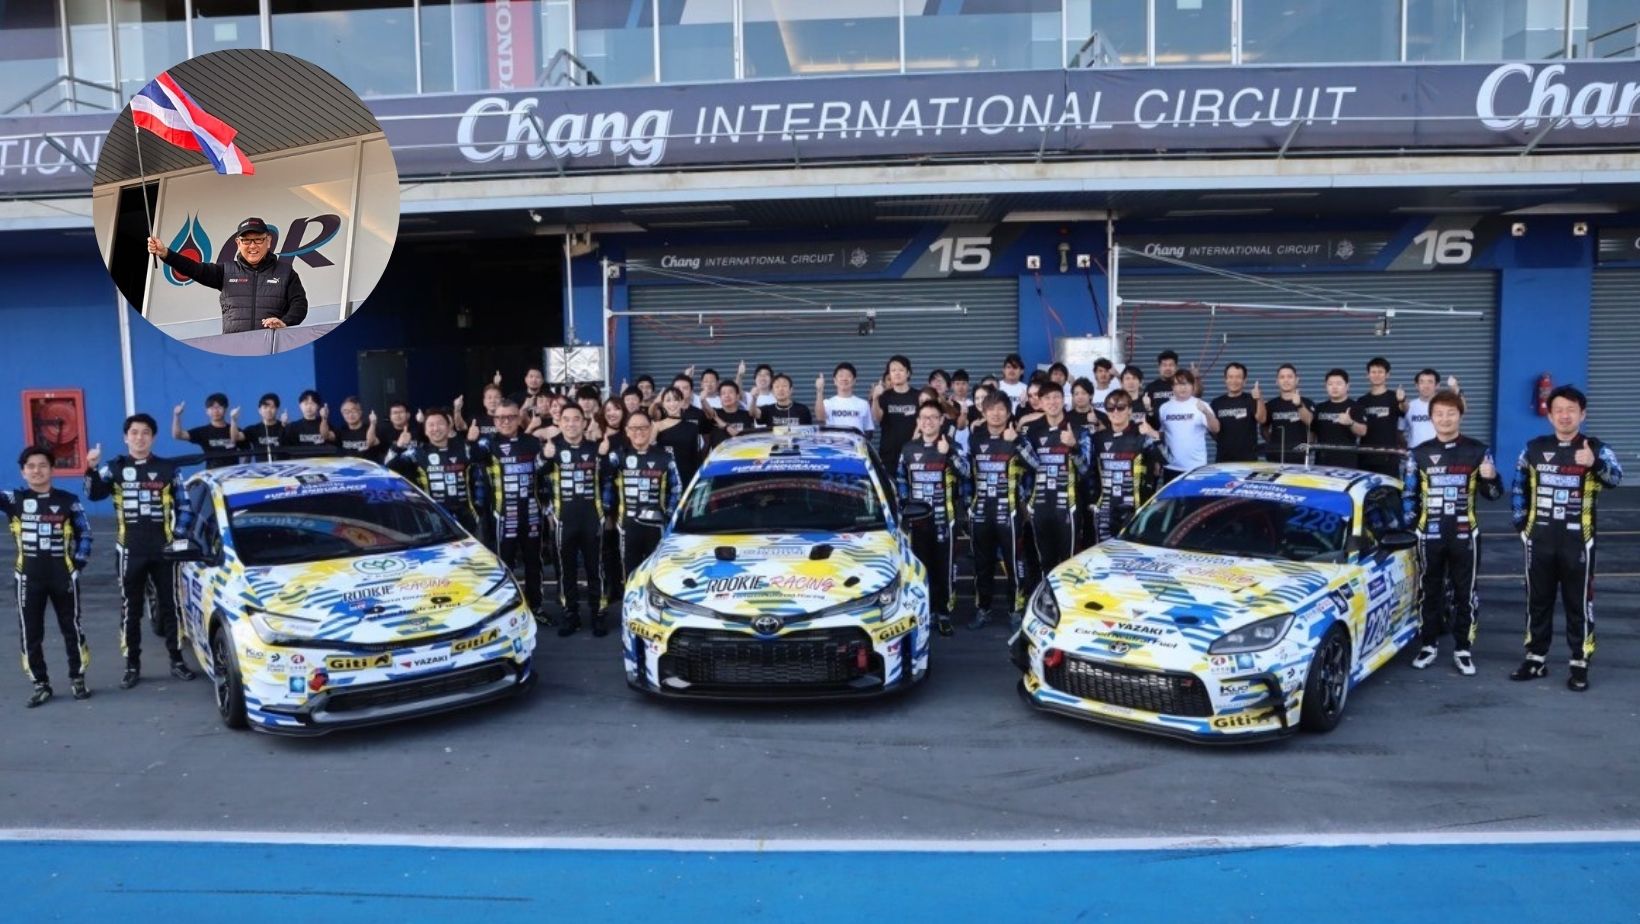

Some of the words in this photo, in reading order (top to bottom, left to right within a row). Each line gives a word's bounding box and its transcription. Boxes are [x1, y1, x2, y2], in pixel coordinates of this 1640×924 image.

[458, 97, 673, 166] Chang
[694, 87, 1111, 144] INTERNATIONAL
[1134, 86, 1356, 128] CIRCUIT
[929, 236, 992, 272] 15
[1143, 242, 1184, 259] Chang
[1189, 246, 1272, 255] INTERNATIONAL
[1276, 244, 1321, 255] CIRCUIT
[1413, 230, 1474, 265] 16
[660, 255, 700, 270] Chang
[705, 256, 787, 267] INTERNATIONAL
[791, 254, 834, 265] CIRCUIT
[1289, 506, 1340, 533] 228
[705, 575, 767, 594] ROOKIE
[769, 576, 836, 592] RACING
[342, 585, 395, 603] ROOKIE
[1117, 622, 1164, 636] YAZAKI
[455, 636, 484, 651] Giti
[329, 658, 367, 669] Giti
[414, 655, 448, 667] YAZAKI
[1214, 715, 1250, 728] Giti
